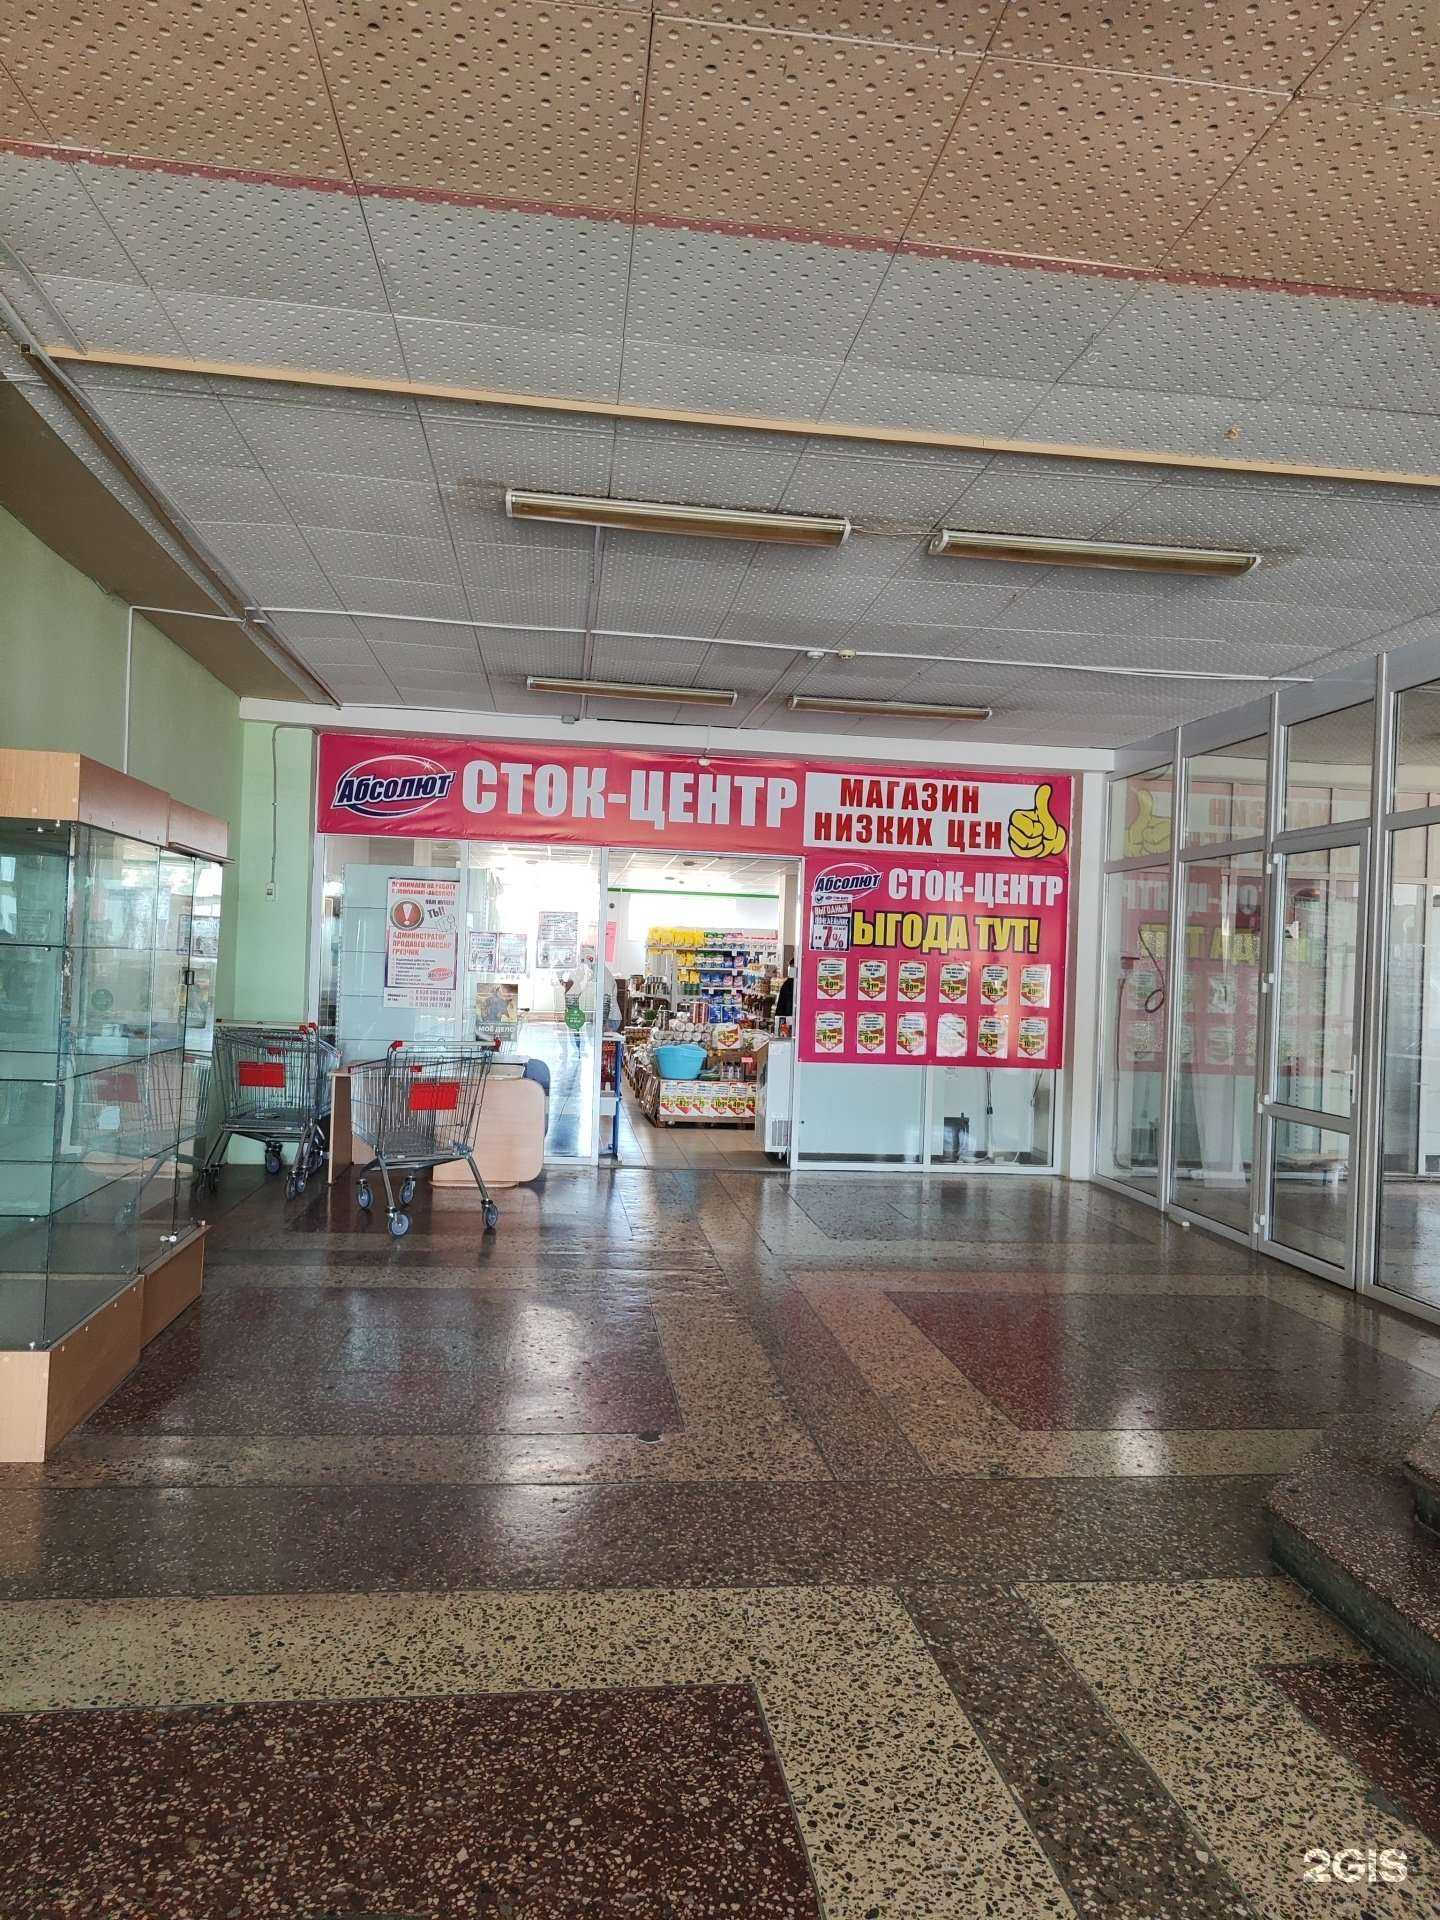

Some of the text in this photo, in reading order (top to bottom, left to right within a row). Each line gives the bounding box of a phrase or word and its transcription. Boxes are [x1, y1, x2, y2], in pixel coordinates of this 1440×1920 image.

[462, 759, 798, 830] СТОК-ЦЕНТР
[840, 778, 980, 814] МАГАЗИН
[814, 812, 1002, 852] НИЗКИХ ЦЕН
[888, 868, 1064, 908] СТОК-ЦЕНТР
[852, 909, 1042, 955] ЫГОДА ТУТ!
